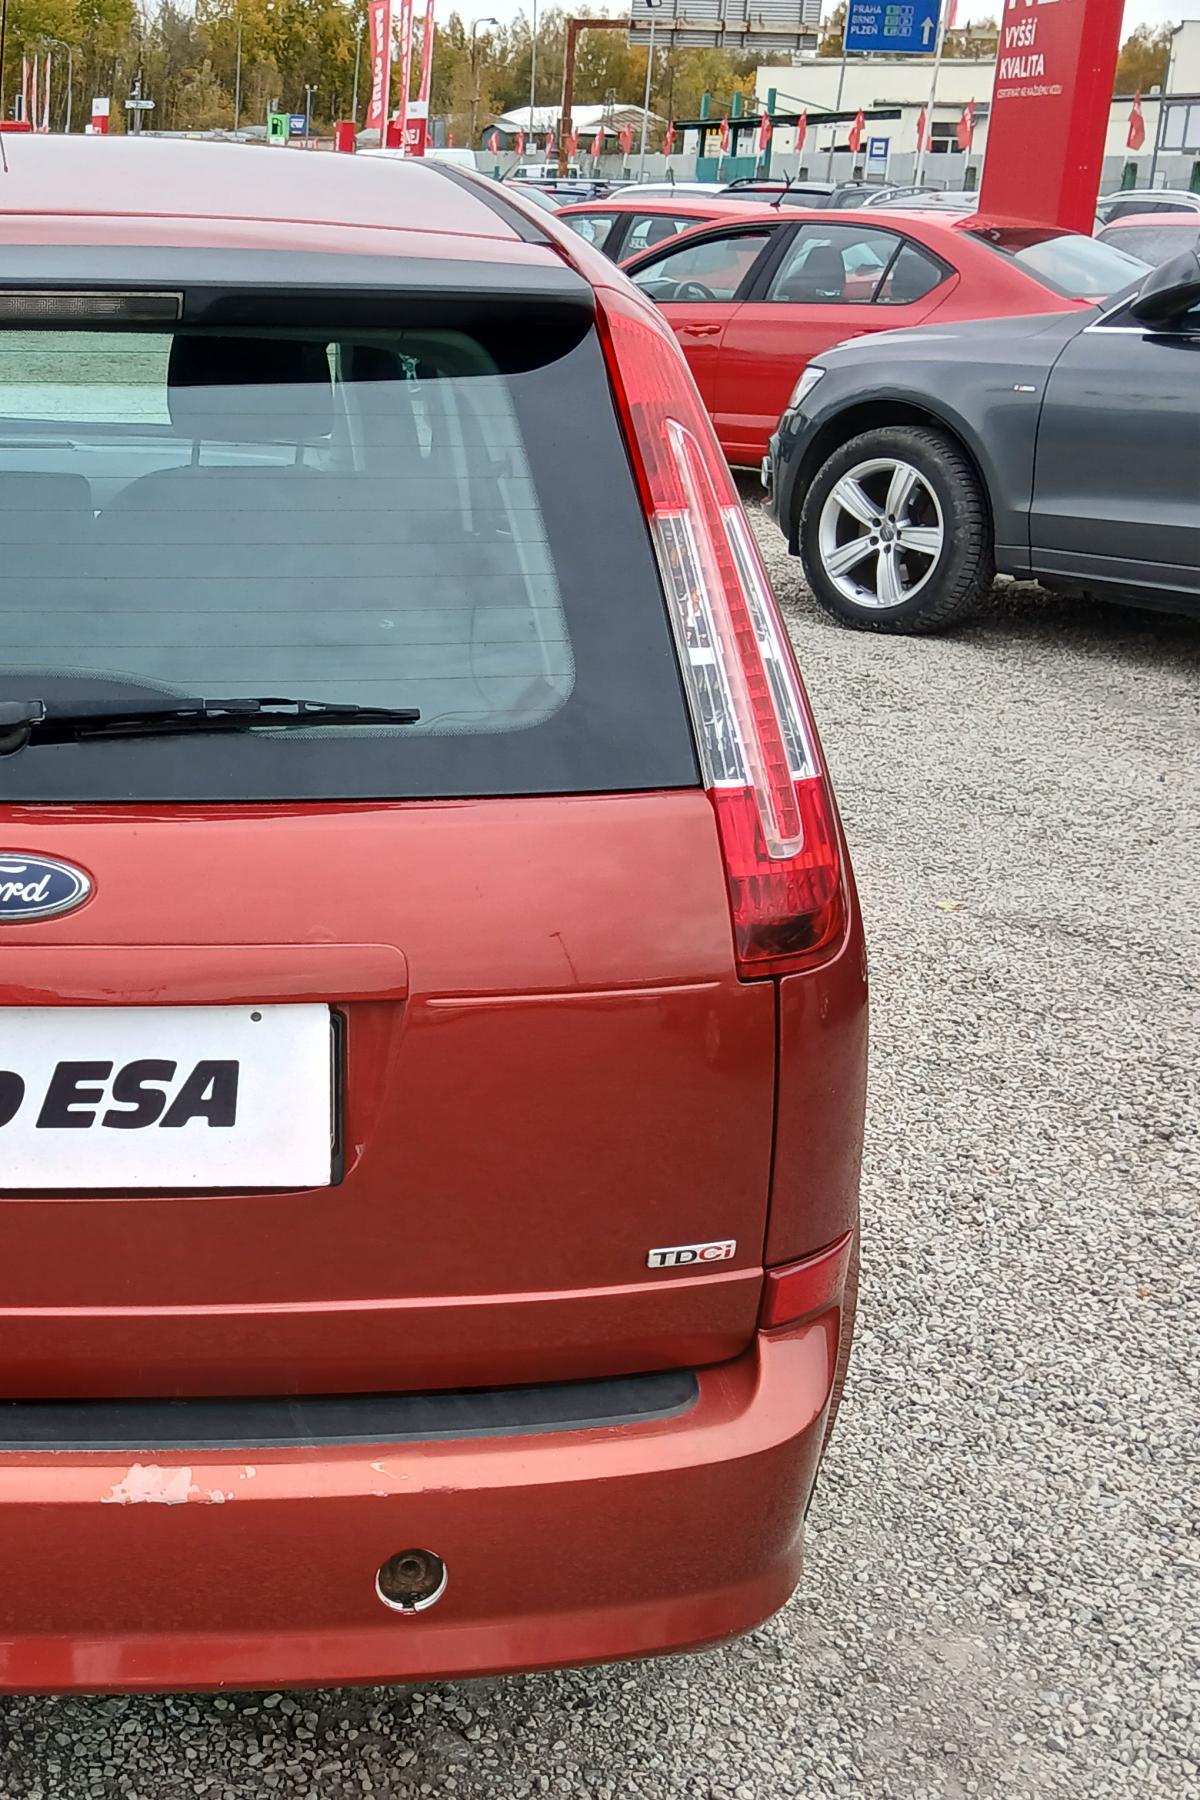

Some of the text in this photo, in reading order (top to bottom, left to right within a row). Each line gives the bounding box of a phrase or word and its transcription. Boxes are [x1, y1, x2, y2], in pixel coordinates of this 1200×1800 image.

[853, 4, 882, 14] PRAHA
[1005, 17, 1038, 49] VYŠŠÍ
[999, 53, 1045, 80] KVALITA
[35, 1058, 240, 1129] ESA
[652, 1244, 733, 1266] TDCi
